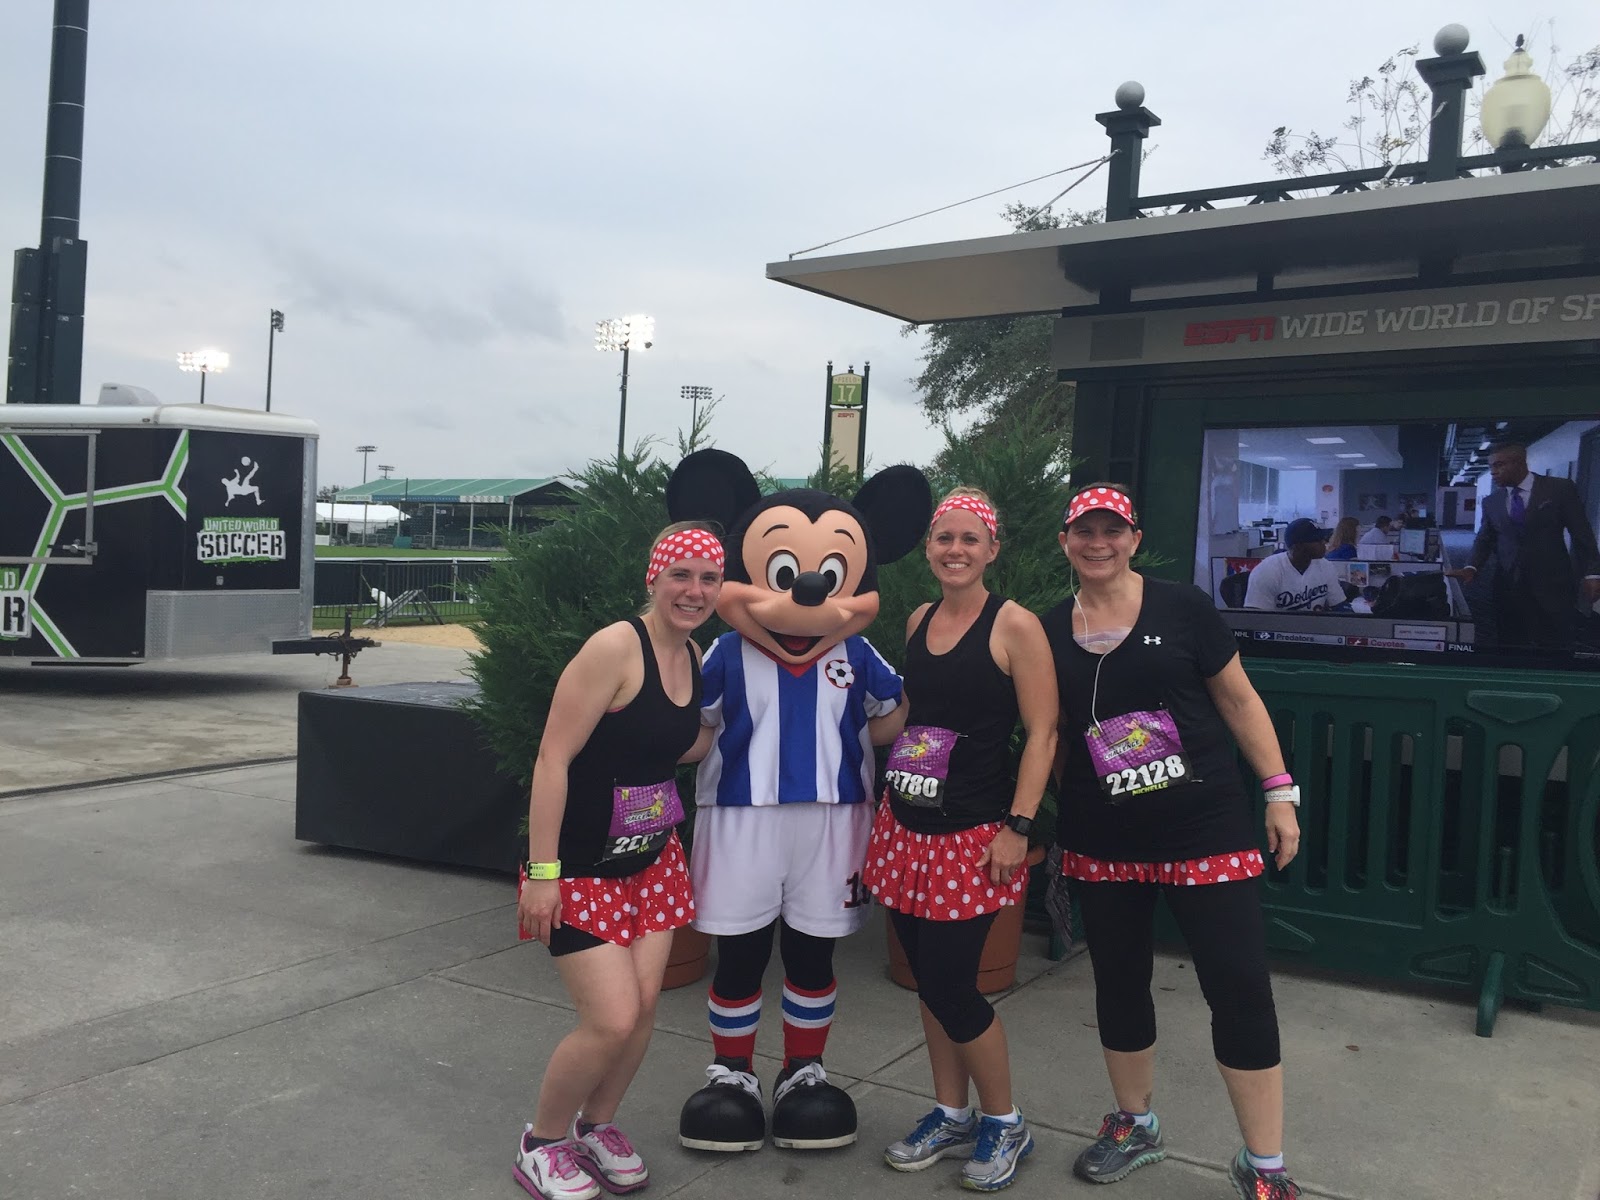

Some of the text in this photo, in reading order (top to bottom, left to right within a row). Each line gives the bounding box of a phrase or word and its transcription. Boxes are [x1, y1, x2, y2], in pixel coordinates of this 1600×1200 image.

[1183, 317, 1277, 346] ESPN
[1280, 309, 1368, 339] WIDE
[1374, 299, 1501, 333] WORLD
[1506, 296, 1554, 325] OF
[837, 384, 856, 403] 17
[204, 519, 278, 533] UNITED WORLD
[201, 533, 282, 558] SOCCER
[1276, 584, 1328, 610] Dodgers
[1233, 630, 1250, 639] NHL
[1275, 633, 1315, 643] Predators
[1370, 640, 1406, 649] Coyotes
[1448, 643, 1475, 653] FINAL
[1106, 755, 1186, 796] 22128
[1132, 781, 1169, 797] MICHELLE
